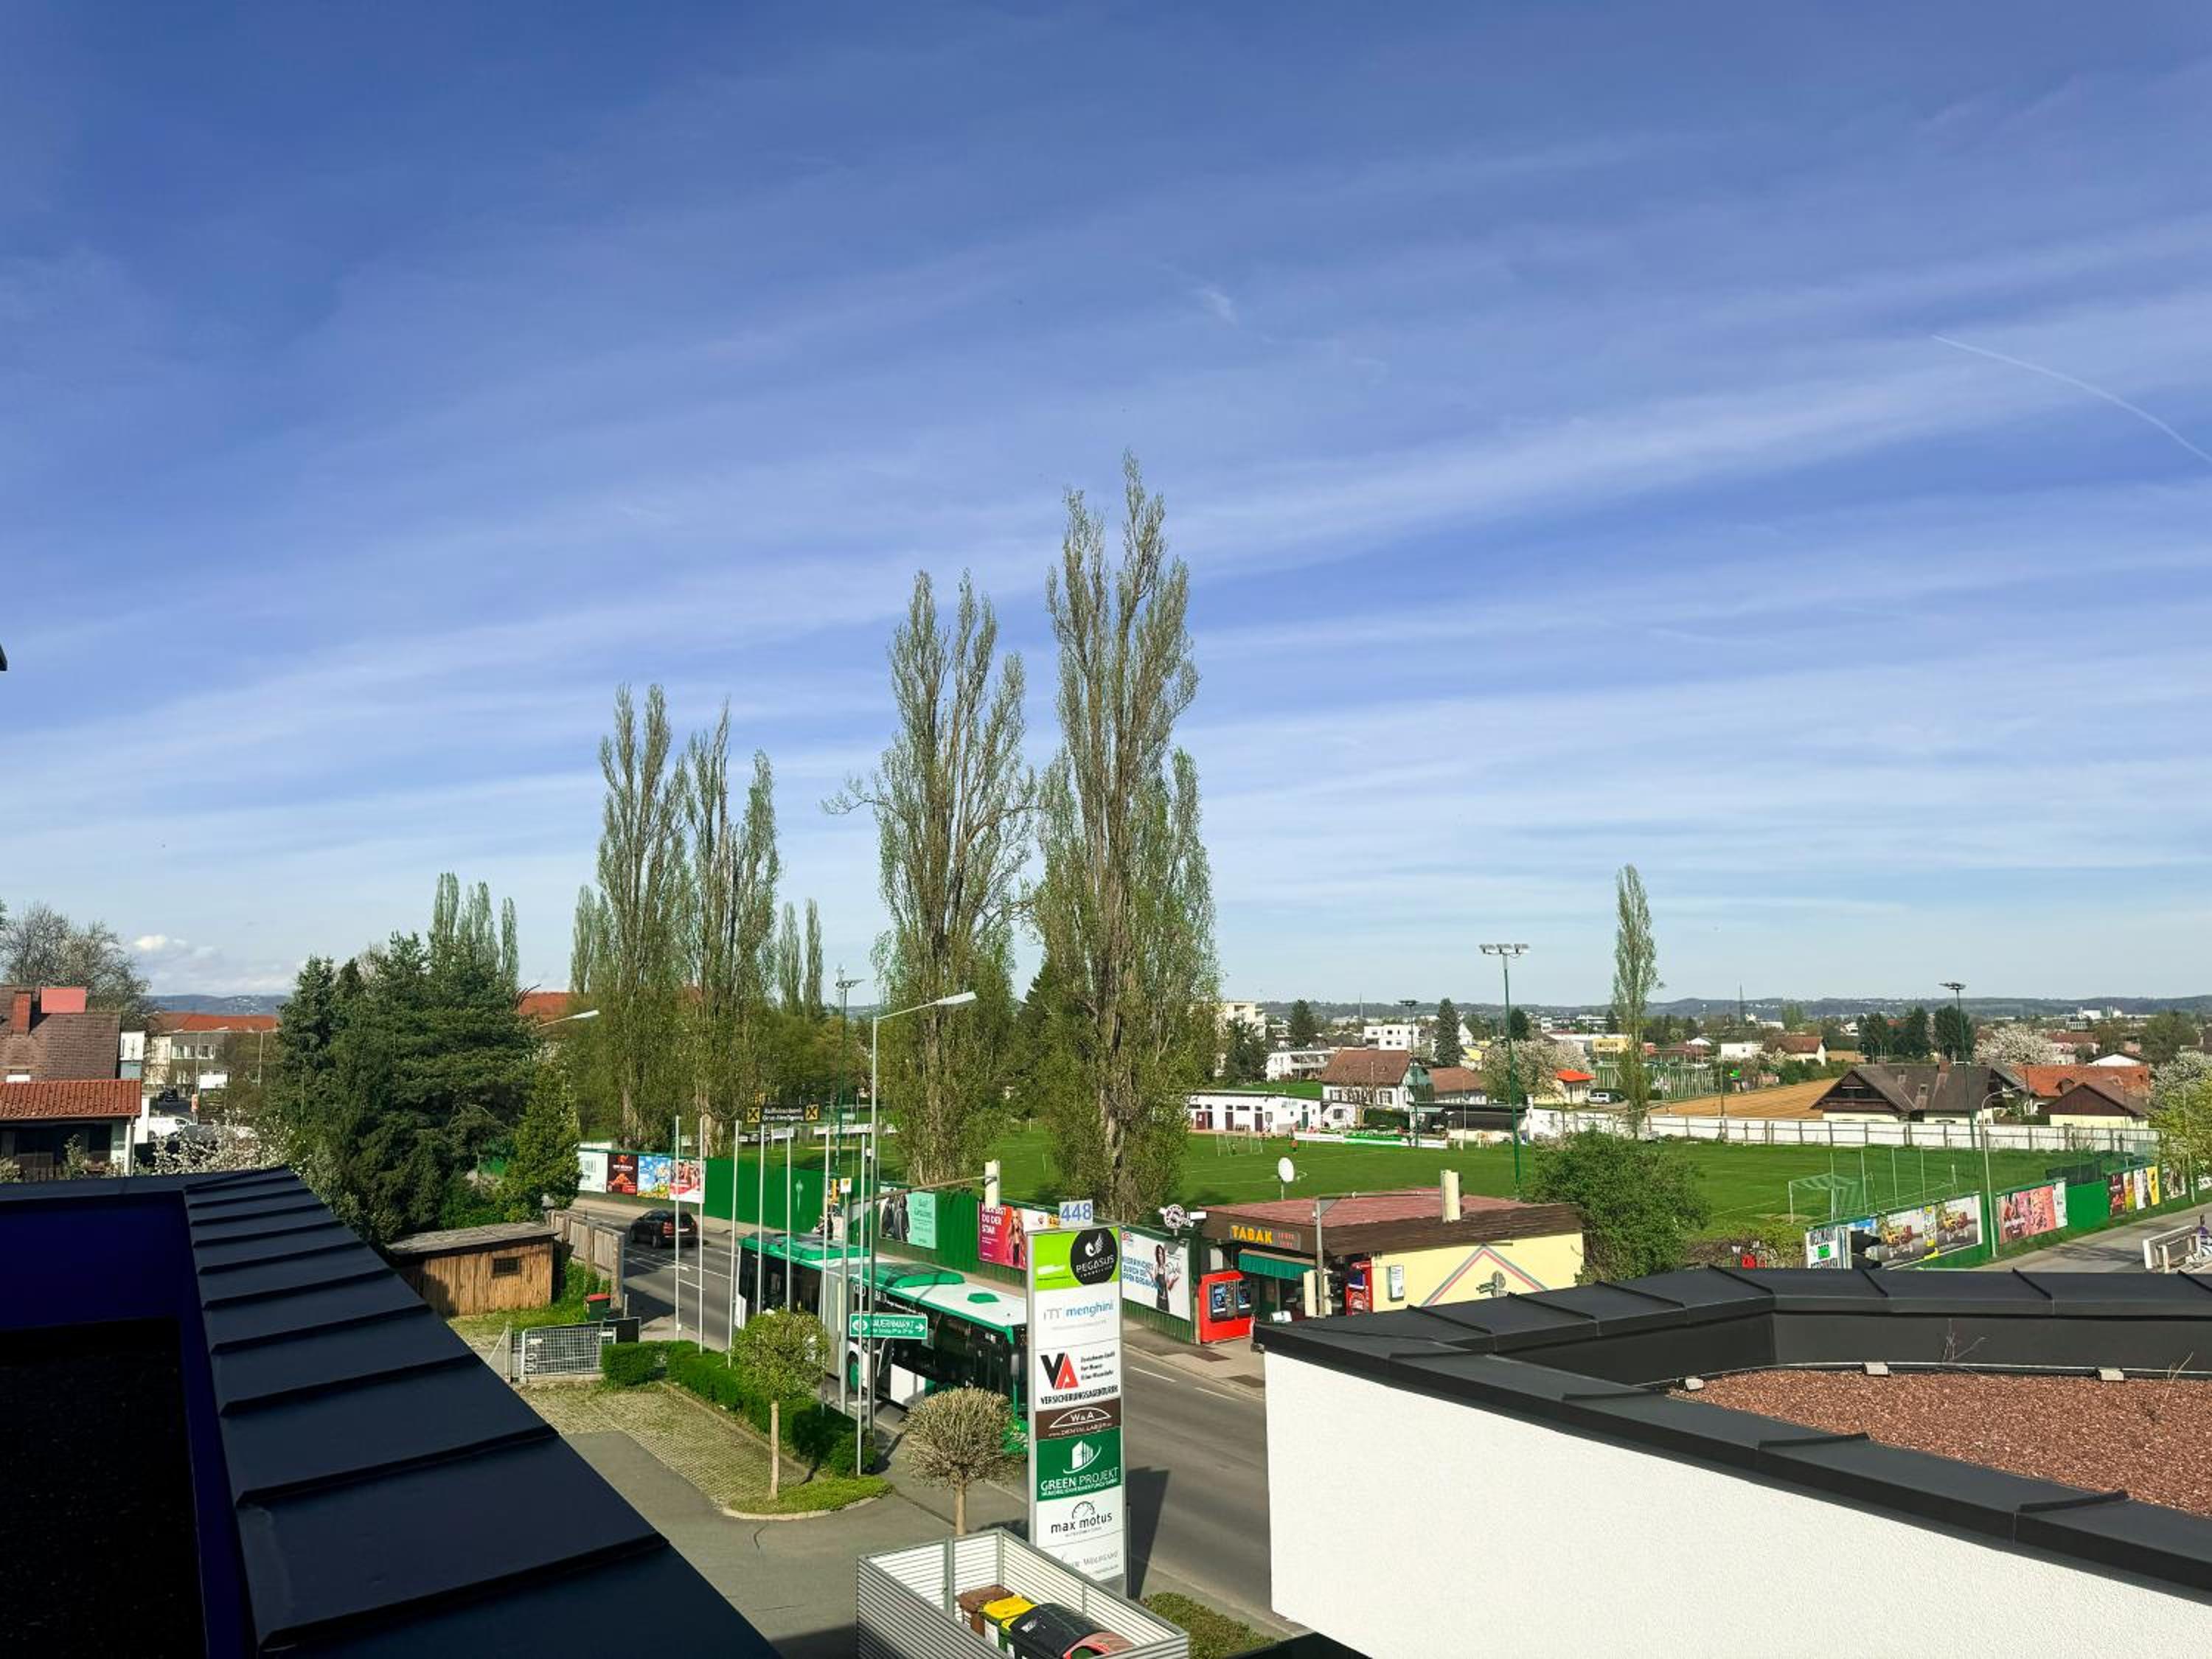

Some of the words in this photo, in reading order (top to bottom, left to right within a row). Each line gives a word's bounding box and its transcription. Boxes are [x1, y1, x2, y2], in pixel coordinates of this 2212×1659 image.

[1060, 1203, 1092, 1222] 448
[1231, 1225, 1273, 1245] TABAK
[1076, 1254, 1114, 1273] PEGASUS
[1065, 1299, 1114, 1318] menghini
[871, 1319, 914, 1329] AUERNMARKT
[1040, 1477, 1077, 1492] GREEN
[1079, 1467, 1119, 1485] PROJEKT
[1051, 1522, 1076, 1534] max
[1079, 1512, 1113, 1528] motus
